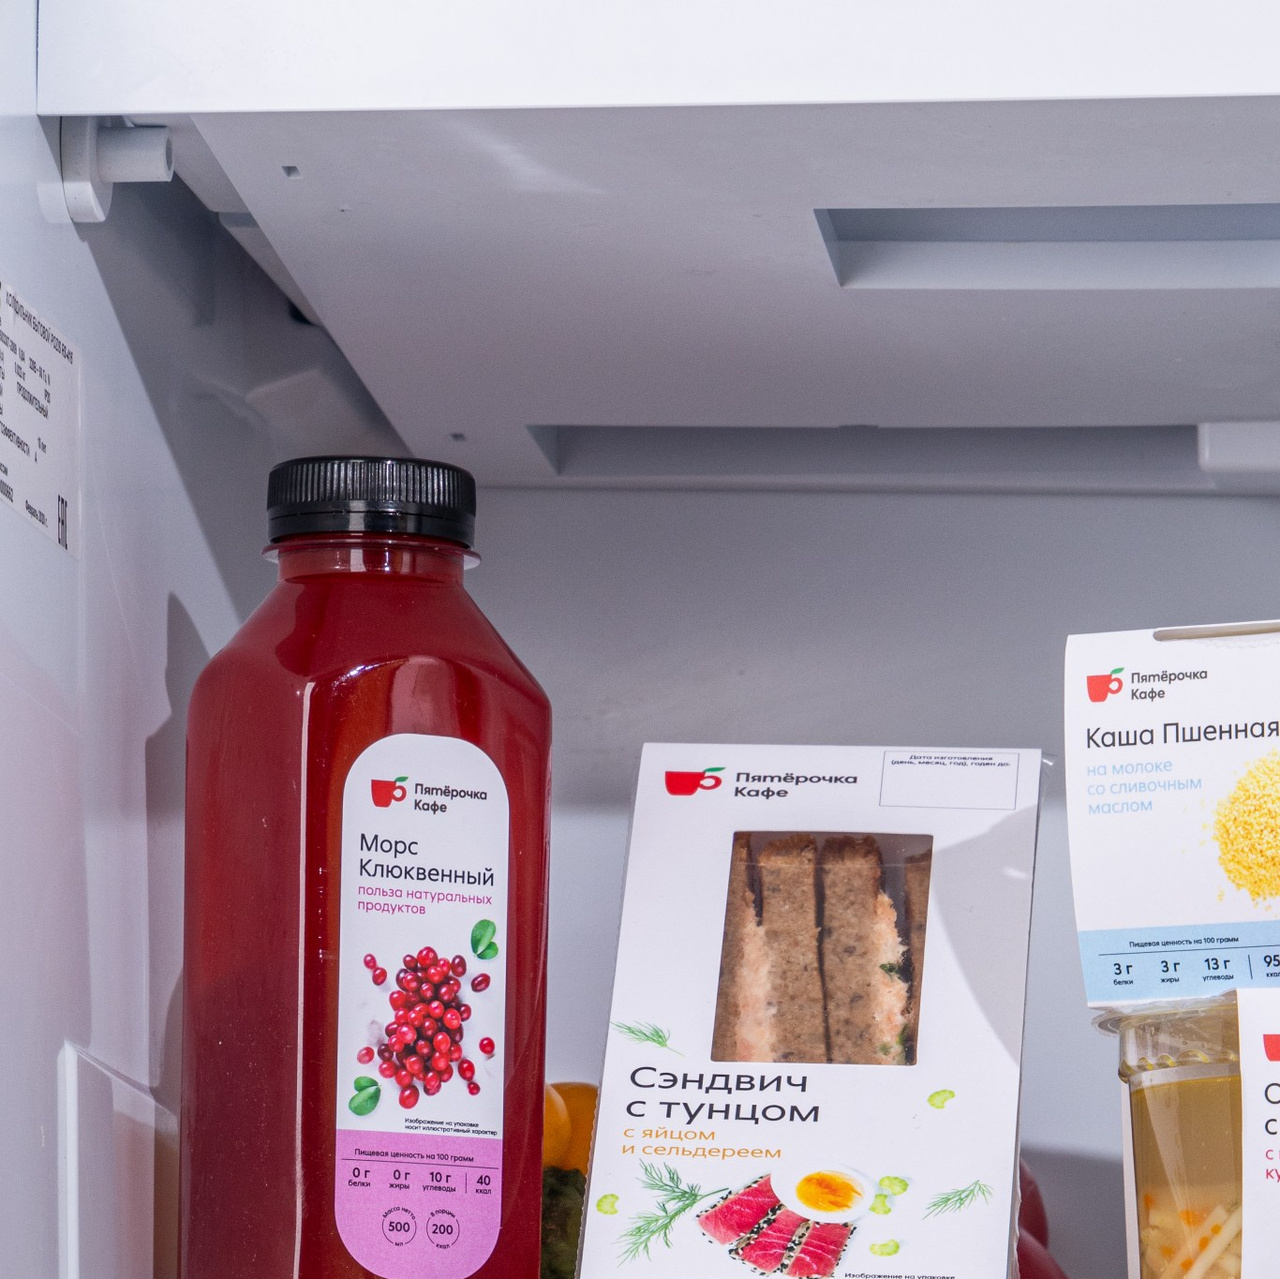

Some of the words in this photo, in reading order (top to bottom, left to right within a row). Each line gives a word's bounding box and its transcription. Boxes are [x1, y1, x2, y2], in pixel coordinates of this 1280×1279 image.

[1130, 668, 1208, 685] Пятёрочка
[1130, 687, 1165, 702] Кафе
[1086, 727, 1154, 750] Каша
[1163, 720, 1280, 744] Пшенная
[1086, 764, 1107, 776] на
[1112, 759, 1173, 775] молоке
[736, 772, 858, 788] Пятёрочка
[1088, 783, 1106, 796] со
[1110, 776, 1202, 795] сливочным
[414, 783, 487, 801] Пятёрочка
[734, 786, 788, 800] Кафе
[414, 799, 447, 814] Кафе
[1088, 798, 1153, 815] маслом
[360, 833, 418, 858] Морс
[359, 858, 494, 886] Клюквенный
[358, 885, 403, 898] польза
[406, 890, 493, 905] натуральных
[357, 901, 426, 915] продуктов
[1161, 961, 1169, 973] 3
[1174, 962, 1180, 972] г
[1204, 958, 1219, 970] 13
[1224, 959, 1230, 970] г
[1264, 955, 1280, 968] 95
[1114, 963, 1122, 975] 3
[1126, 964, 1133, 974] г
[629, 1066, 808, 1095] Сэндвич
[625, 1100, 646, 1118] с
[659, 1101, 820, 1125] тунцом
[1264, 1119, 1279, 1135] с
[624, 1128, 635, 1139] с
[642, 1126, 716, 1143] яйцом
[355, 1149, 388, 1157] Пищевая
[391, 1152, 424, 1160] ценность
[621, 1144, 635, 1155] и
[641, 1144, 782, 1161] сельдереем
[1265, 1149, 1274, 1160] с
[352, 1167, 360, 1178] 0
[364, 1170, 370, 1178] г
[393, 1170, 400, 1180] 0
[405, 1172, 410, 1180] г
[429, 1172, 442, 1182] 10
[446, 1174, 451, 1183] г
[348, 1179, 371, 1187] белки
[477, 1175, 491, 1186] 40
[422, 1184, 456, 1192] углеводы
[382, 1206, 400, 1219] Масса
[401, 1207, 416, 1220] нетто
[435, 1209, 455, 1218] порции
[388, 1222, 410, 1232] 500
[432, 1224, 453, 1235] 200
